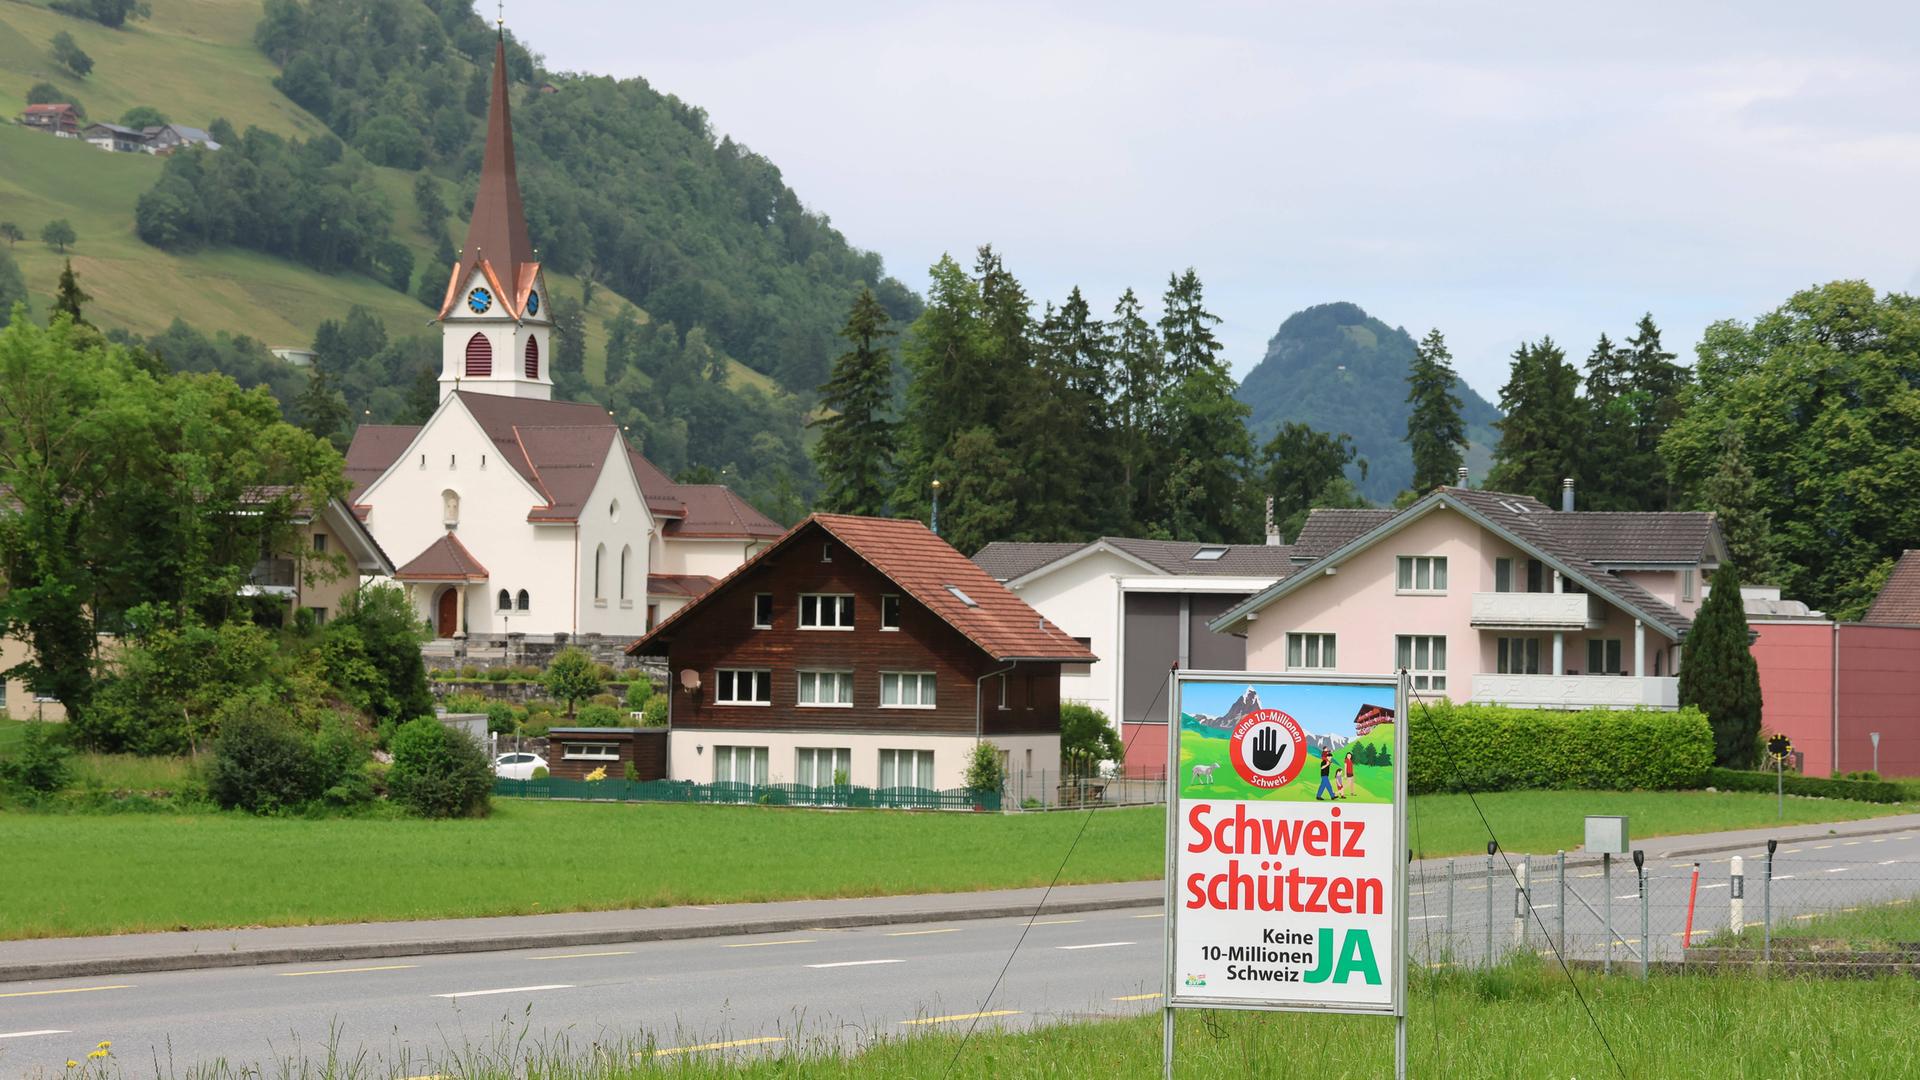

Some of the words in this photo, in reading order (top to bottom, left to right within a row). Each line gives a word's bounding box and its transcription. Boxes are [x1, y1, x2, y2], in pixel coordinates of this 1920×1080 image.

[1233, 718, 1255, 741] Keine
[1255, 711, 1302, 743] 10-Millionen
[1251, 775, 1287, 787] Schweiz
[1187, 804, 1366, 858] Schweiz
[1186, 860, 1384, 915] schützen
[1263, 928, 1314, 945] Keine
[1201, 945, 1313, 964] 10-Millionen
[1303, 928, 1383, 985] JA
[1226, 965, 1299, 983] Schweiz
